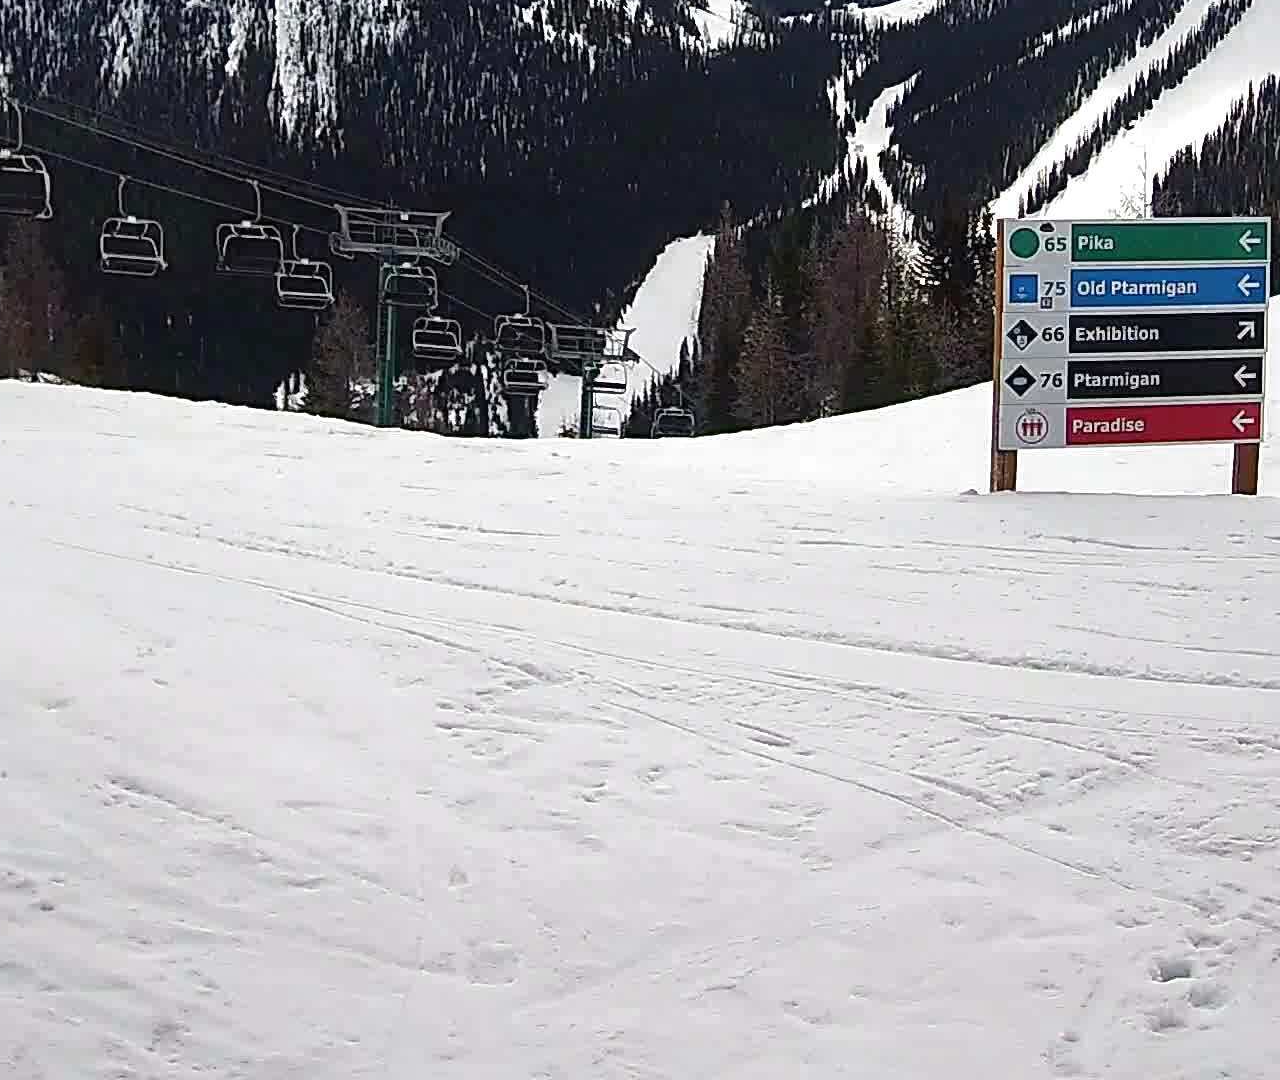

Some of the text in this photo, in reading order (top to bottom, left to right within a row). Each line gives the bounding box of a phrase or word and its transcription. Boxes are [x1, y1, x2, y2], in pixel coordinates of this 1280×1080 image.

[1043, 235, 1114, 253] 65 Pika
[1043, 279, 1198, 298] 75 Old Ptarmigan
[1041, 326, 1160, 343] 66 Exhibition
[1039, 372, 1160, 390] 76 Ptarmigan
[1072, 418, 1145, 434] Paradise
